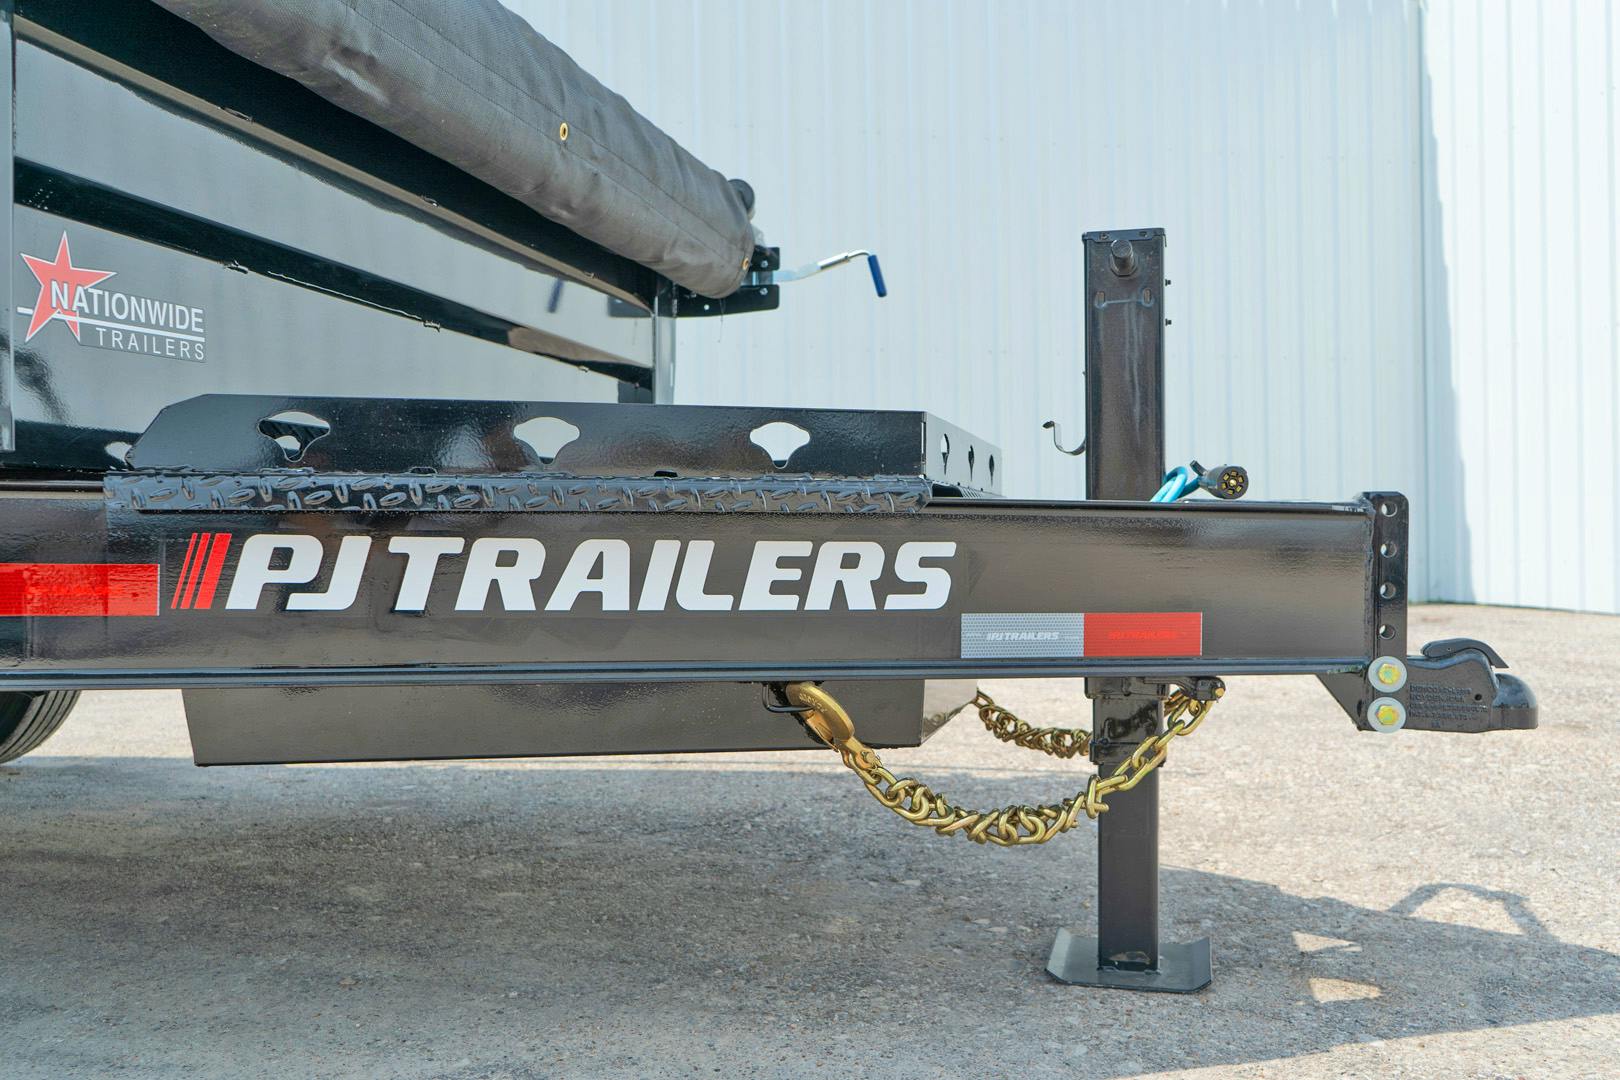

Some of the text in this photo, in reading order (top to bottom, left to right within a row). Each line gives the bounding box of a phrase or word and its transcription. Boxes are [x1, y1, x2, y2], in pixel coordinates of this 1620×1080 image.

[51, 280, 204, 333] NATIONWIDE
[95, 327, 204, 360] TRAILERS
[225, 534, 957, 612] PJ TRAILERS
